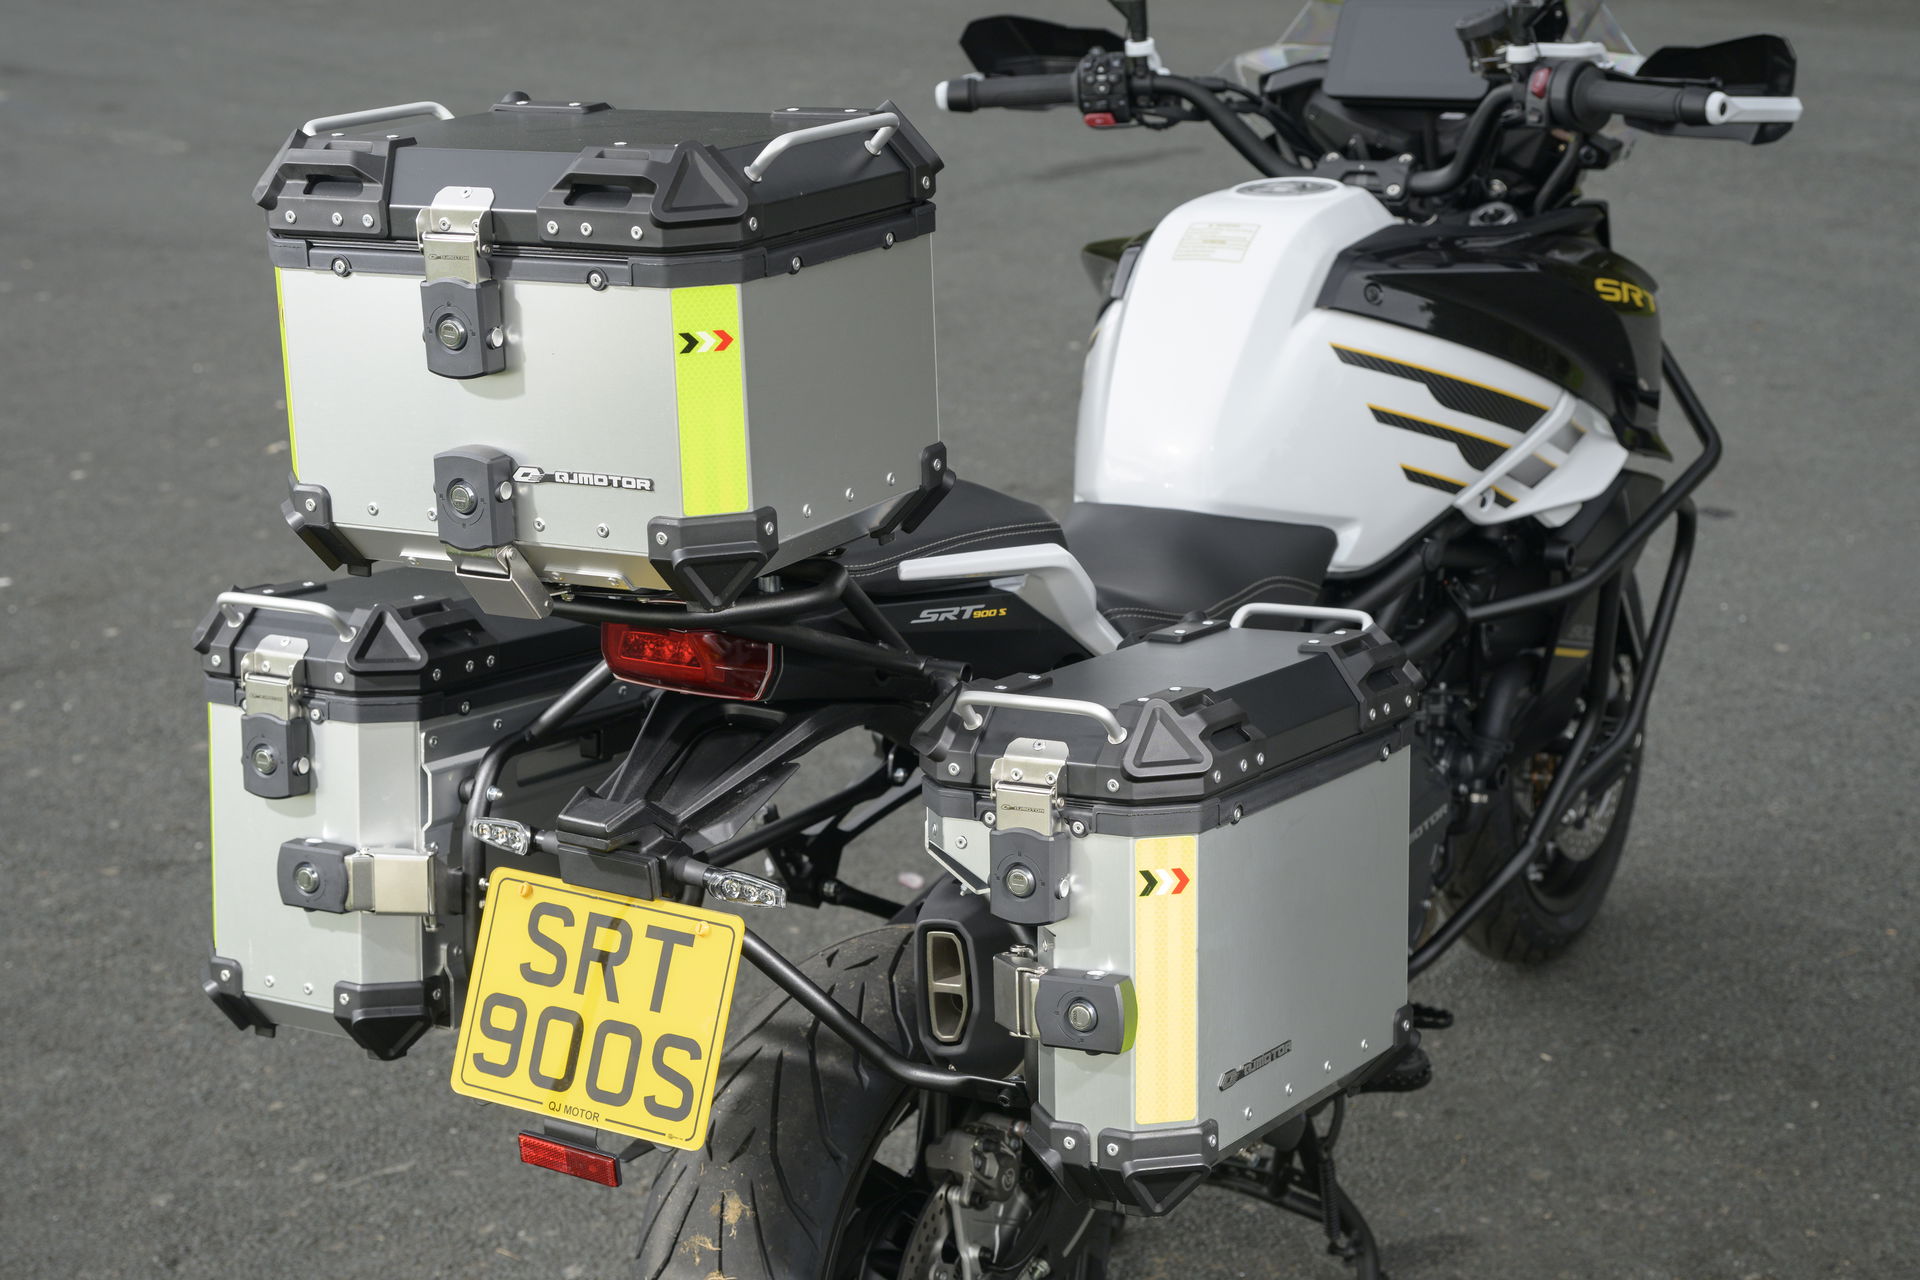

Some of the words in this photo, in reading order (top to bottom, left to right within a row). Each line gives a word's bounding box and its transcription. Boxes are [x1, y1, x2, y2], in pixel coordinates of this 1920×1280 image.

[1594, 277, 1656, 312] SRT
[554, 471, 652, 492] QJMOTOR
[910, 604, 986, 624] SRT
[973, 608, 997, 619] 900
[519, 901, 696, 1013] SRT
[472, 992, 703, 1122] 900S
[548, 1101, 562, 1112] QJ
[563, 1104, 600, 1122] MOTOR
